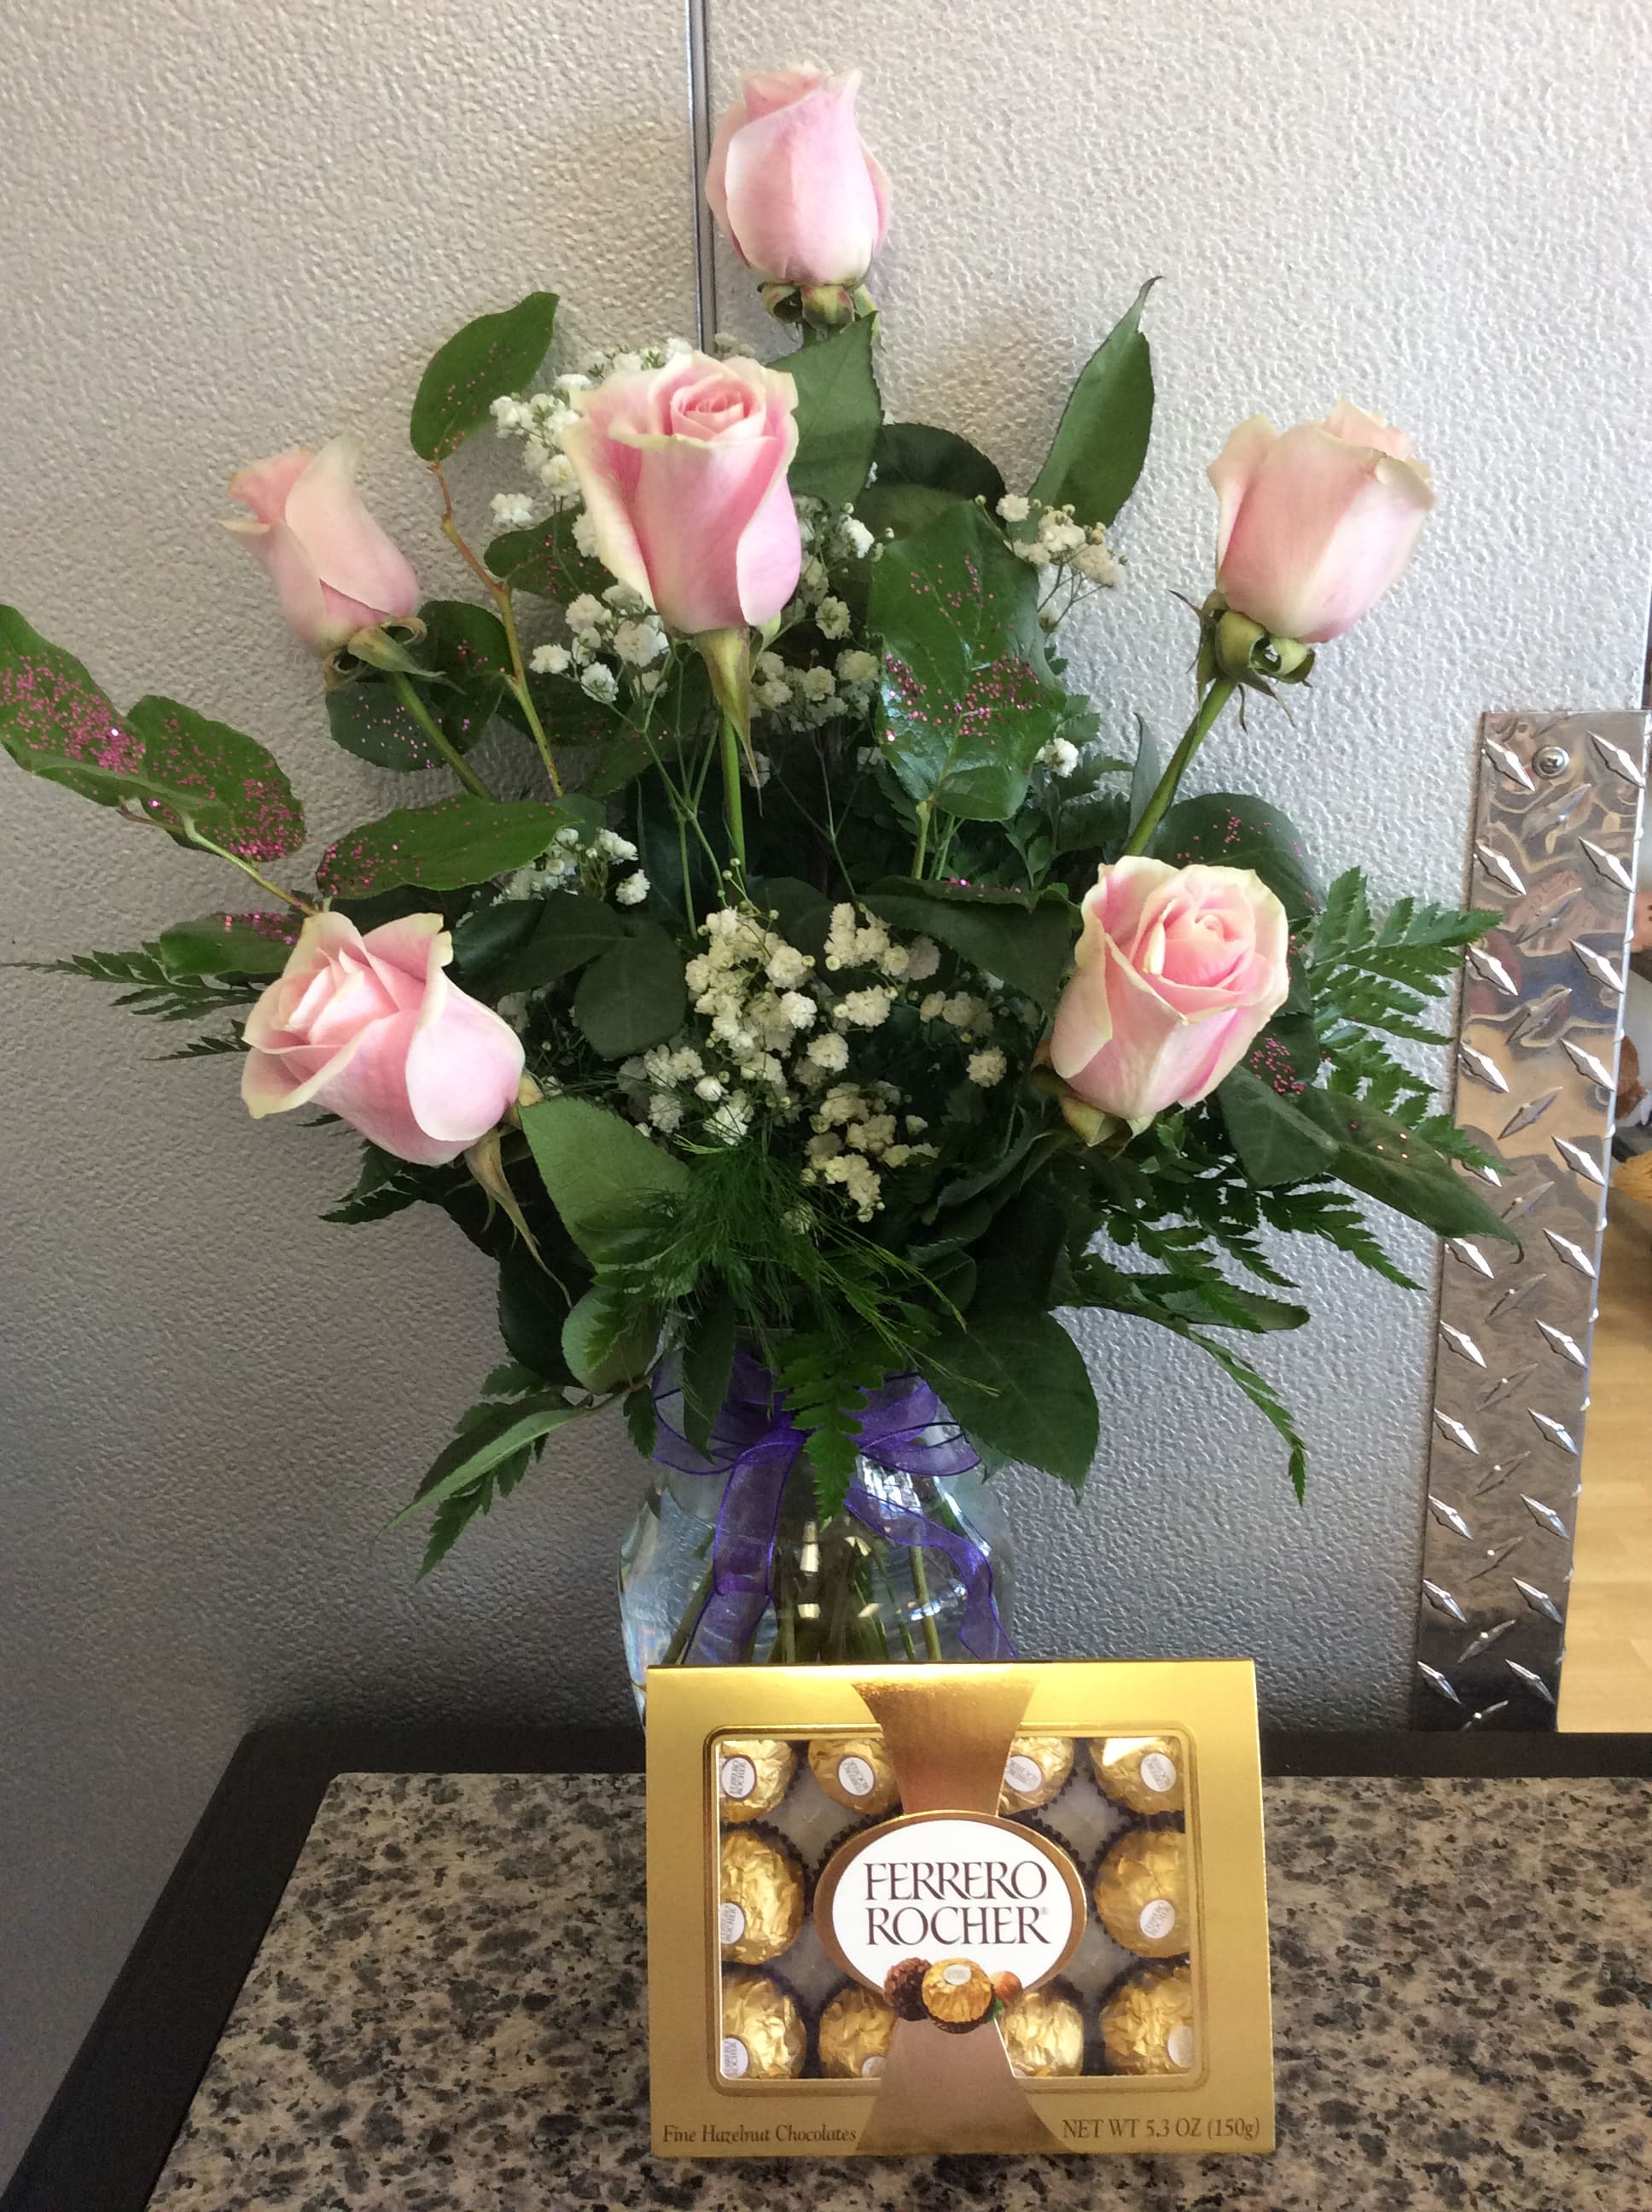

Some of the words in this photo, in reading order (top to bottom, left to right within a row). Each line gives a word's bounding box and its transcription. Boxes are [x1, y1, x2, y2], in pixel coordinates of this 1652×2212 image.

[864, 1860, 1047, 1901] FERRERO
[865, 1906, 1051, 1946] ROCHER
[663, 2124, 695, 2143] Fine
[702, 2124, 770, 2144] Hazelnut
[775, 2123, 857, 2142] Chocolates
[1062, 2118, 1103, 2139] NET
[1108, 2118, 1140, 2138] WT
[1146, 2119, 1170, 2138] 5.3
[1176, 2117, 1202, 2137] OZ
[1207, 2117, 1260, 2140] (150g)
